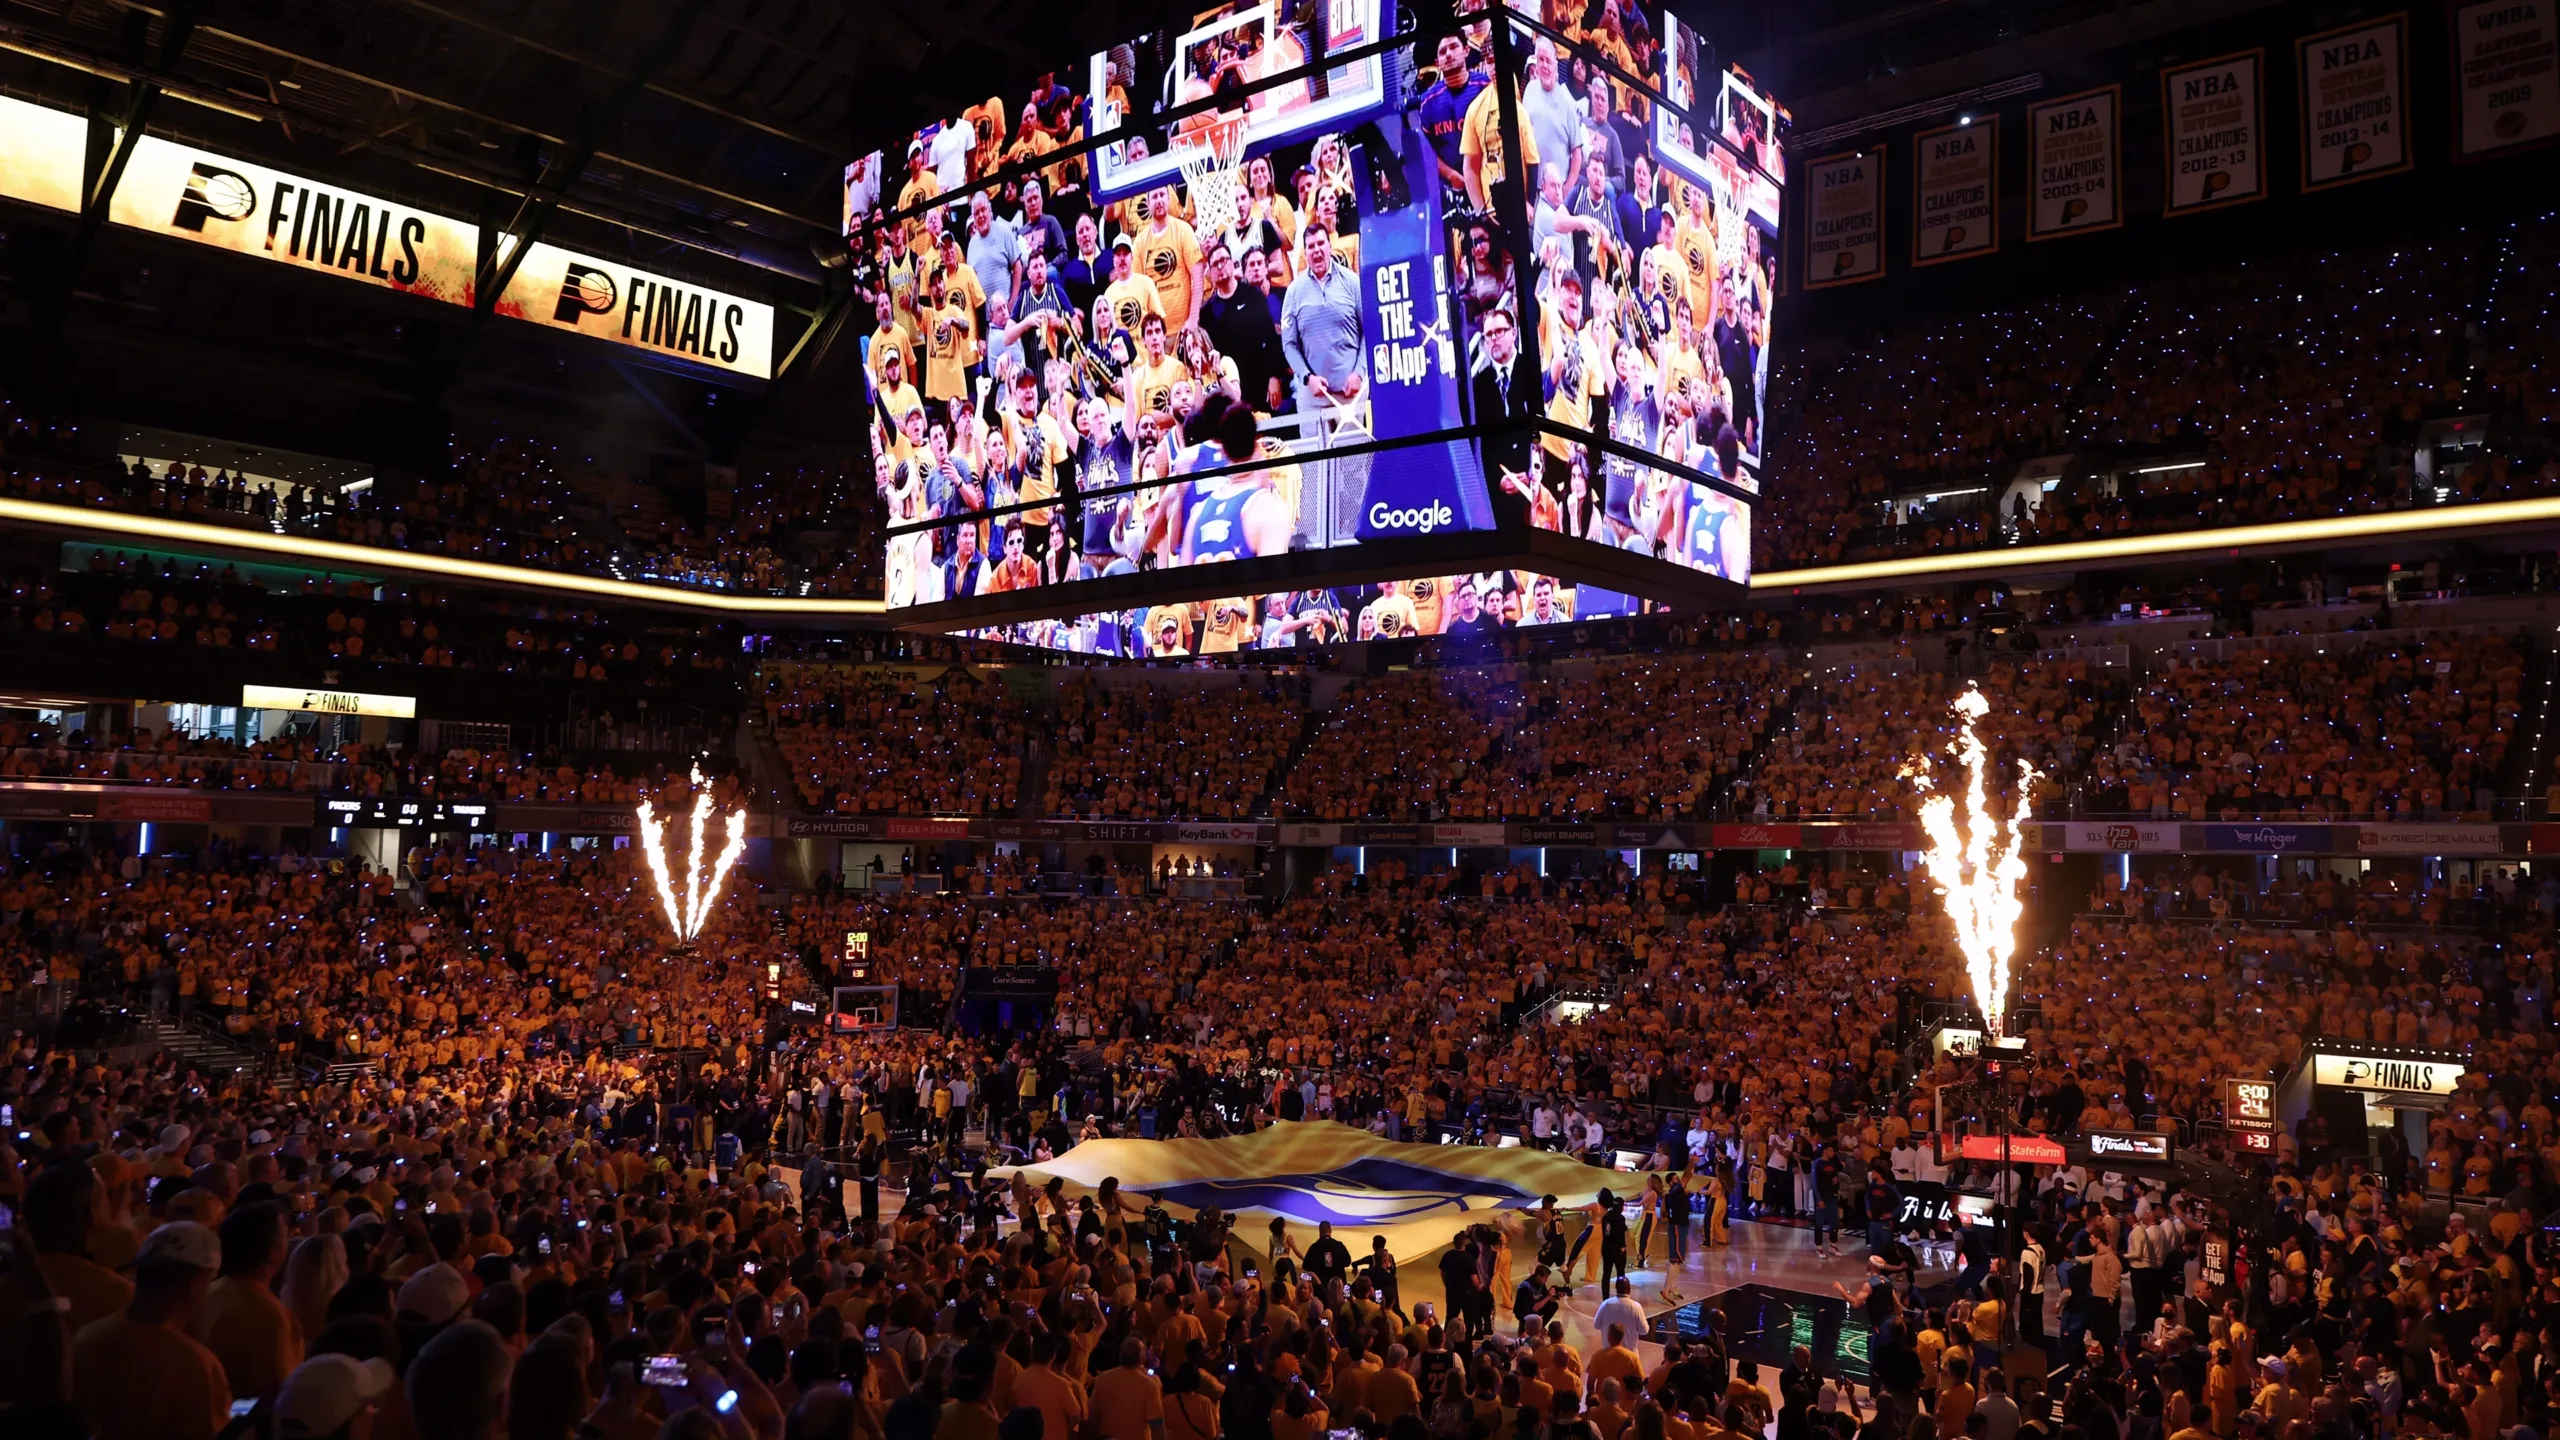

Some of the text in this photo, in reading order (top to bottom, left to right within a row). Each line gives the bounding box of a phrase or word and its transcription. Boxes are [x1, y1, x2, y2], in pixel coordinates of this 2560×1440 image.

[2476, 5, 2537, 31] WNBA
[2322, 39, 2383, 70] NBA
[2184, 72, 2239, 100] NBA
[2488, 85, 2532, 109] 2009
[2049, 107, 2098, 133] NBA
[2317, 96, 2392, 130] CHAMPIONS
[1935, 136, 1977, 159] NBA
[2178, 127, 2248, 156] CHAMPIONS
[1823, 166, 1864, 187] NBA
[2042, 157, 2106, 184] CHAMPIONS
[1924, 185, 1985, 212] CHAMPIONS
[2042, 178, 2106, 200] 2003-04
[264, 181, 425, 285] FINALS
[1815, 212, 1873, 237] CHAMPIONS
[1376, 261, 1411, 304] GET
[622, 277, 743, 363] FINALS
[1378, 300, 1416, 341] THE
[1391, 342, 1427, 386] App
[1369, 498, 1453, 534] Google
[322, 693, 360, 712] FINALS
[579, 814, 640, 828] SHIPSIG
[813, 823, 869, 833] HYUNDAI
[890, 825, 921, 834] STEAK
[930, 825, 963, 834] SHAKE
[1088, 826, 1151, 839] SHIFT 4
[1180, 828, 1228, 841] KeyBank
[1436, 827, 1462, 836] INDIANA
[1533, 831, 1595, 840] SPORT GRAPHICS
[1738, 827, 1772, 847] Lilly
[2086, 833, 2101, 842] 93.5
[2104, 825, 2130, 839] the
[2254, 828, 2297, 849] Kroger
[2381, 835, 2424, 843] KRIEG
[2110, 835, 2139, 849] fan
[846, 942, 866, 960] 24
[993, 976, 1037, 984] CareSource
[1967, 1036, 1981, 1052] FIN
[2374, 1062, 2433, 1091] FINALS
[2238, 1084, 2269, 1100] 12:00
[2240, 1098, 2264, 1114] 24
[2242, 1120, 2273, 1128] TISSOT
[2096, 1136, 2134, 1154] Finals
[2247, 1134, 2270, 1148] 1:30
[2205, 1242, 2221, 1256] GET
[2205, 1255, 2222, 1269] THE
[2209, 1269, 2225, 1286] App
